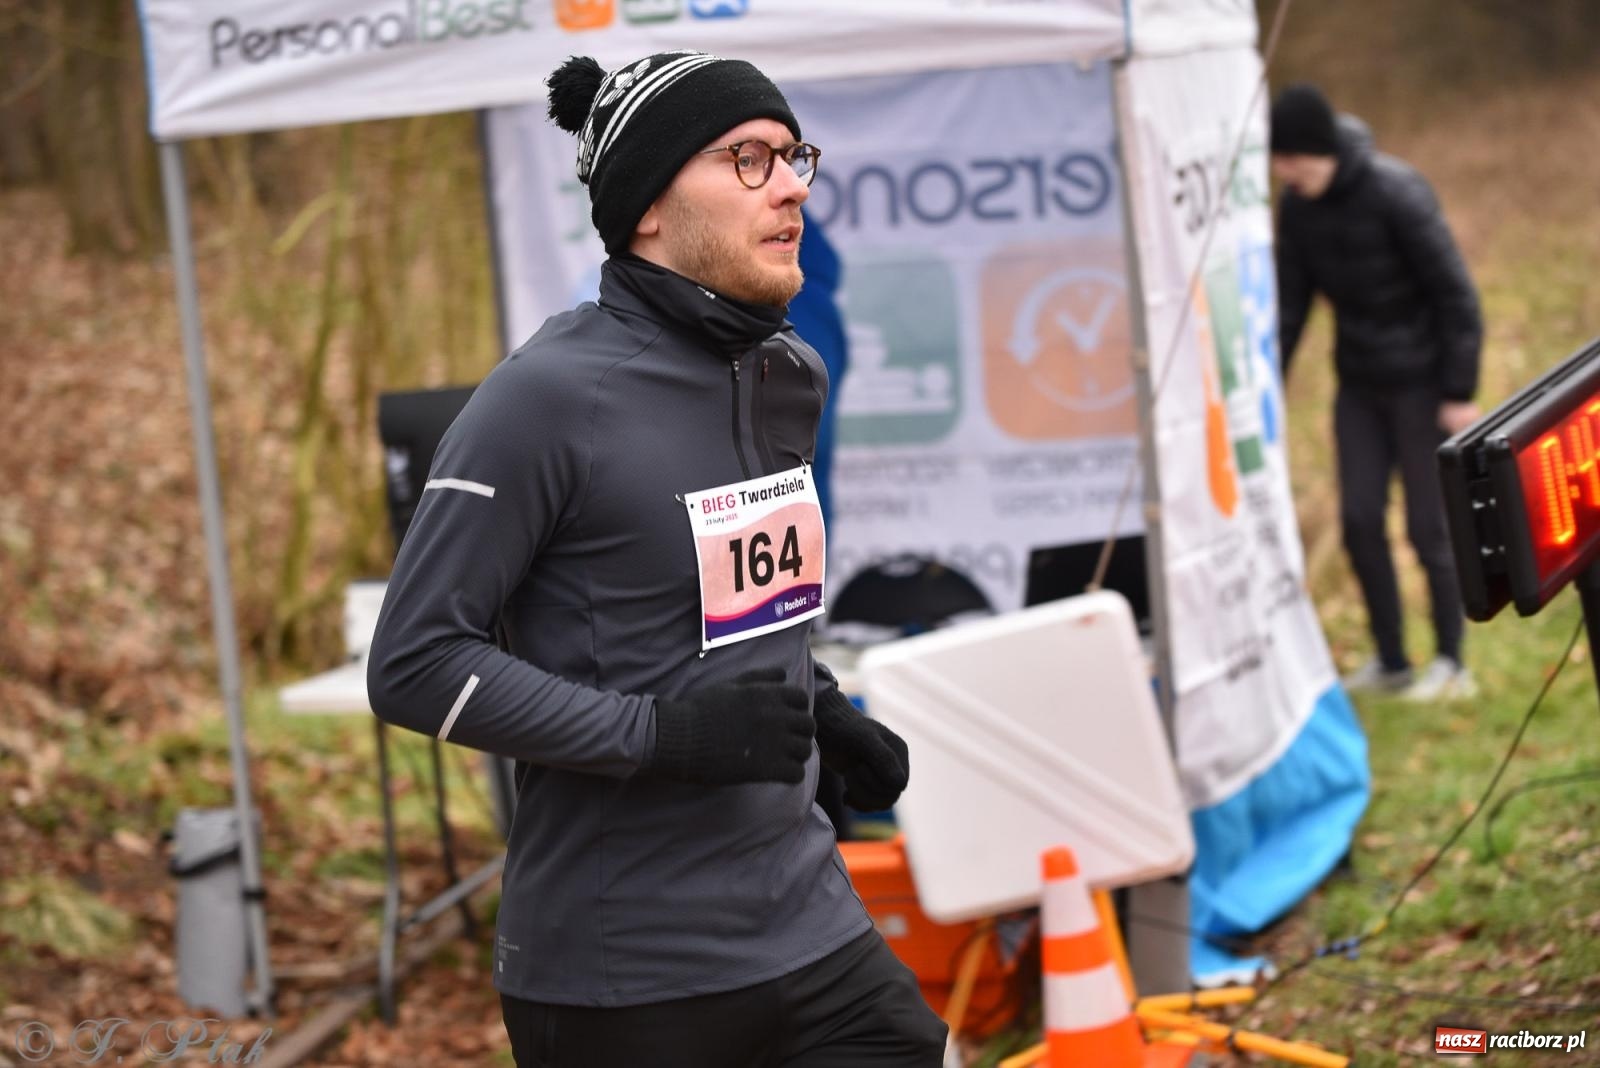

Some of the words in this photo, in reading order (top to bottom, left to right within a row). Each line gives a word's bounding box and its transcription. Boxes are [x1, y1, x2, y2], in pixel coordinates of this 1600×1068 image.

[702, 494, 736, 514] BIEG
[739, 478, 804, 505] Twardziela
[729, 524, 803, 593] 164
